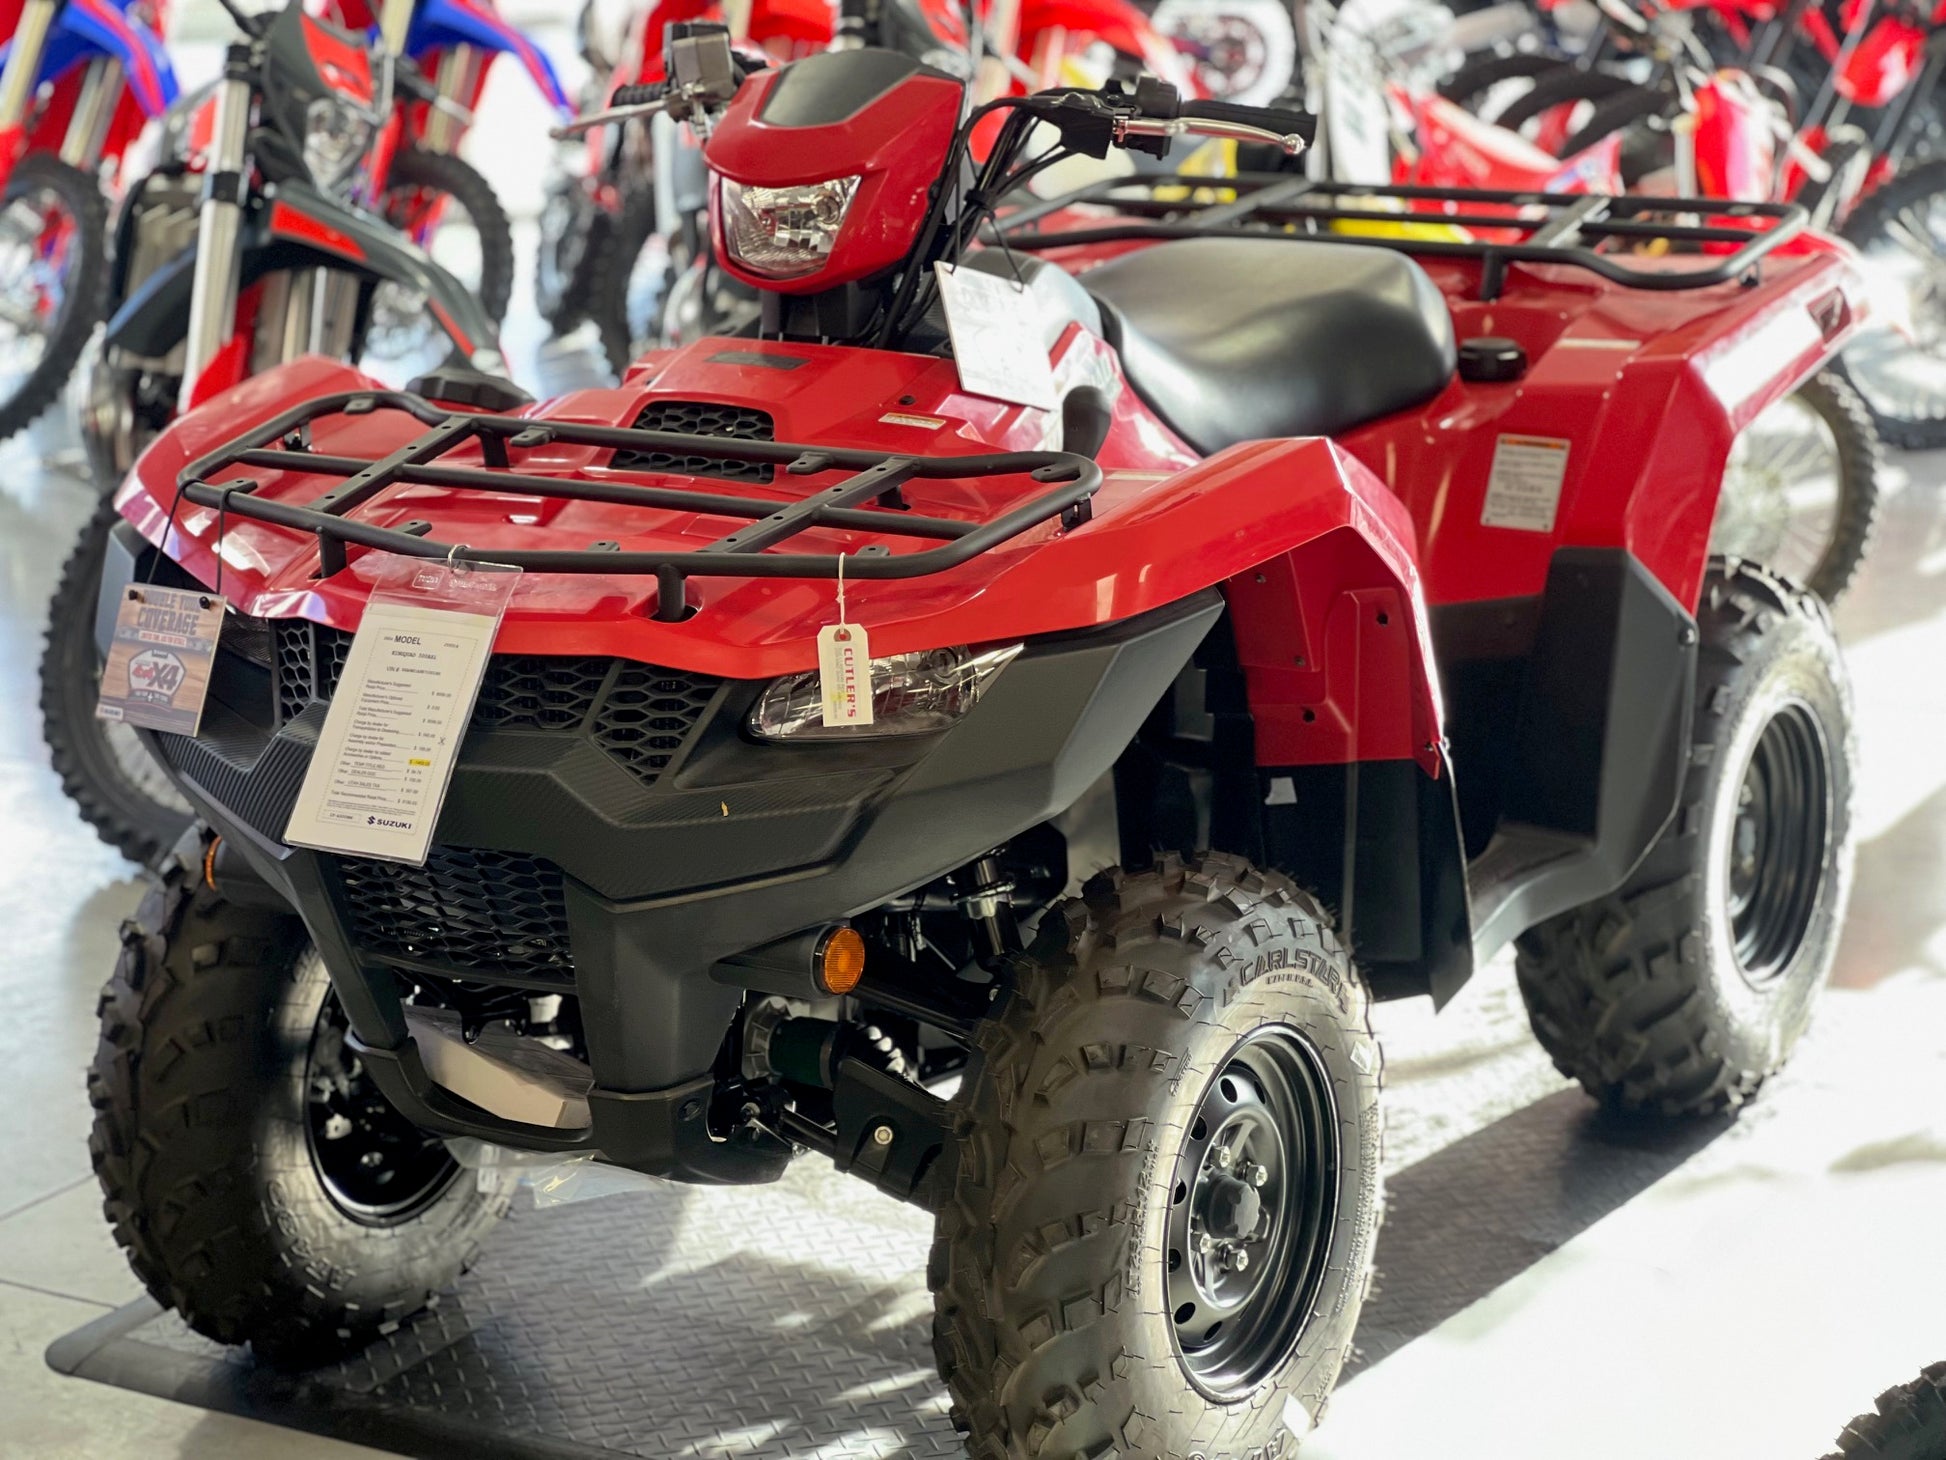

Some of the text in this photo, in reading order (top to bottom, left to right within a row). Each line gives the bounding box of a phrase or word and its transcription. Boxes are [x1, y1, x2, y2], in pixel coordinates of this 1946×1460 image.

[137, 607, 200, 636] COVERAGE
[394, 635, 422, 646] MODEL
[844, 647, 857, 718] CUTLER'S
[376, 818, 412, 830] SUZUKI
